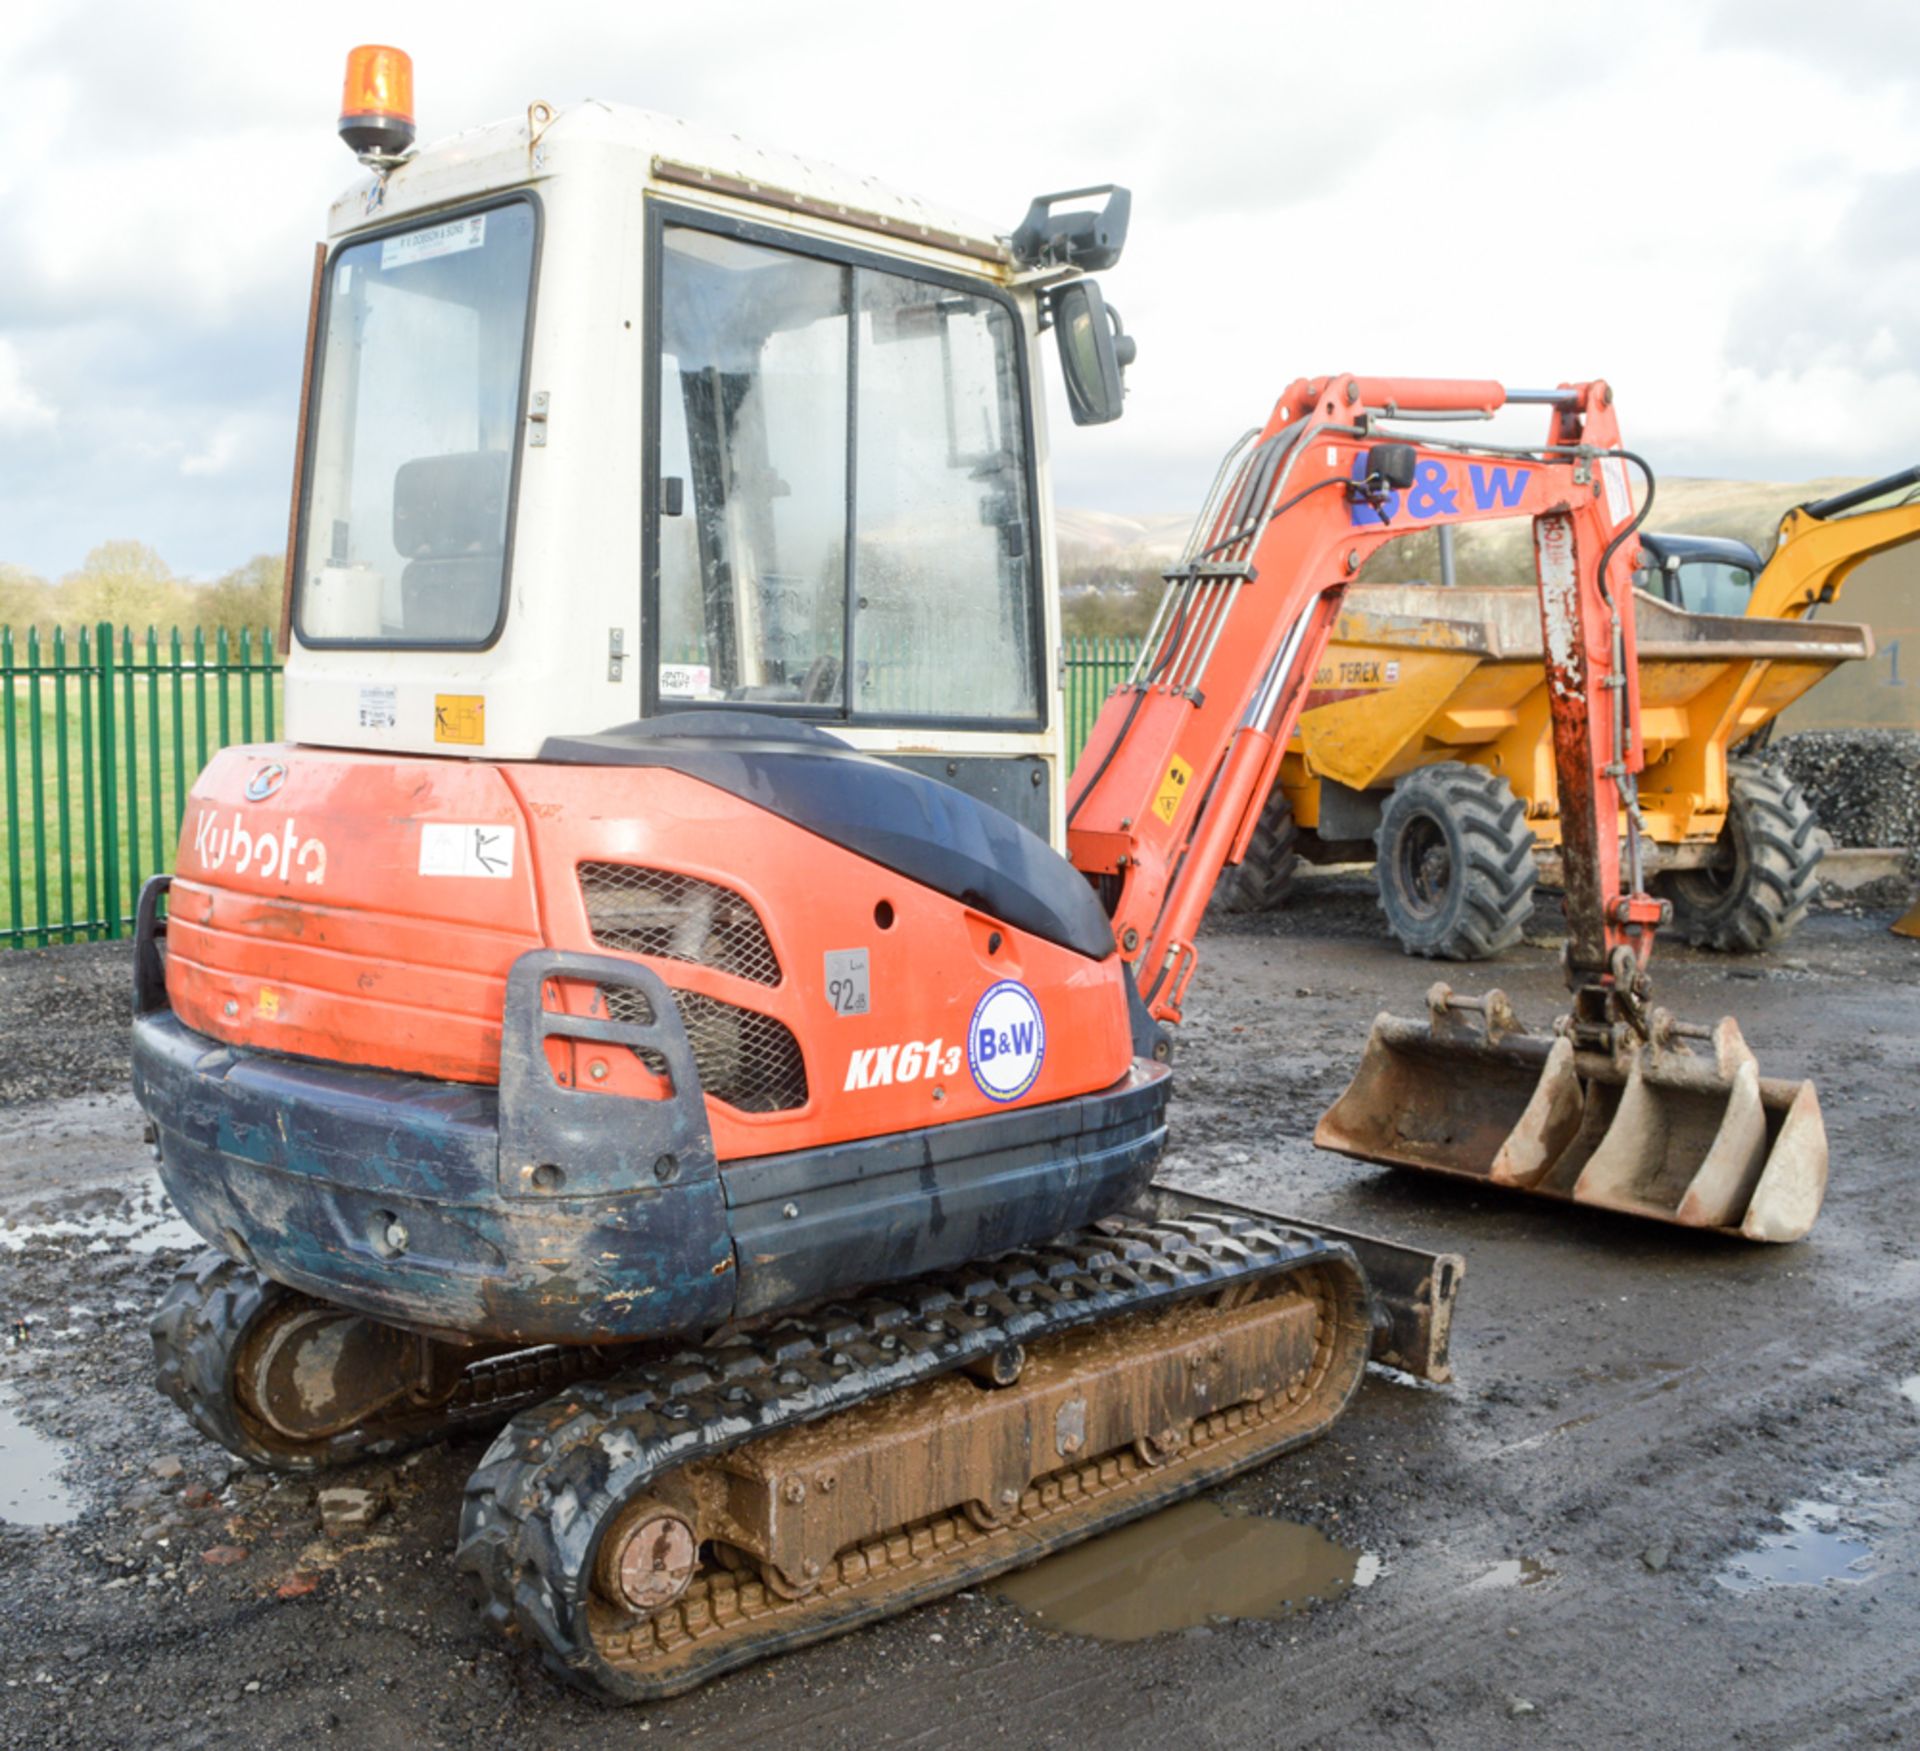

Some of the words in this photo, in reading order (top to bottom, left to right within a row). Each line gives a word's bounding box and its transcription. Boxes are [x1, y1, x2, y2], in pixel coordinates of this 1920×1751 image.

[661, 679, 689, 689] THEFT
[1339, 661, 1380, 683] TEREX
[194, 809, 327, 885] Kubota
[829, 978, 853, 1011] 92
[978, 1020, 1034, 1062] B&W
[843, 1038, 963, 1092] KX61-3
